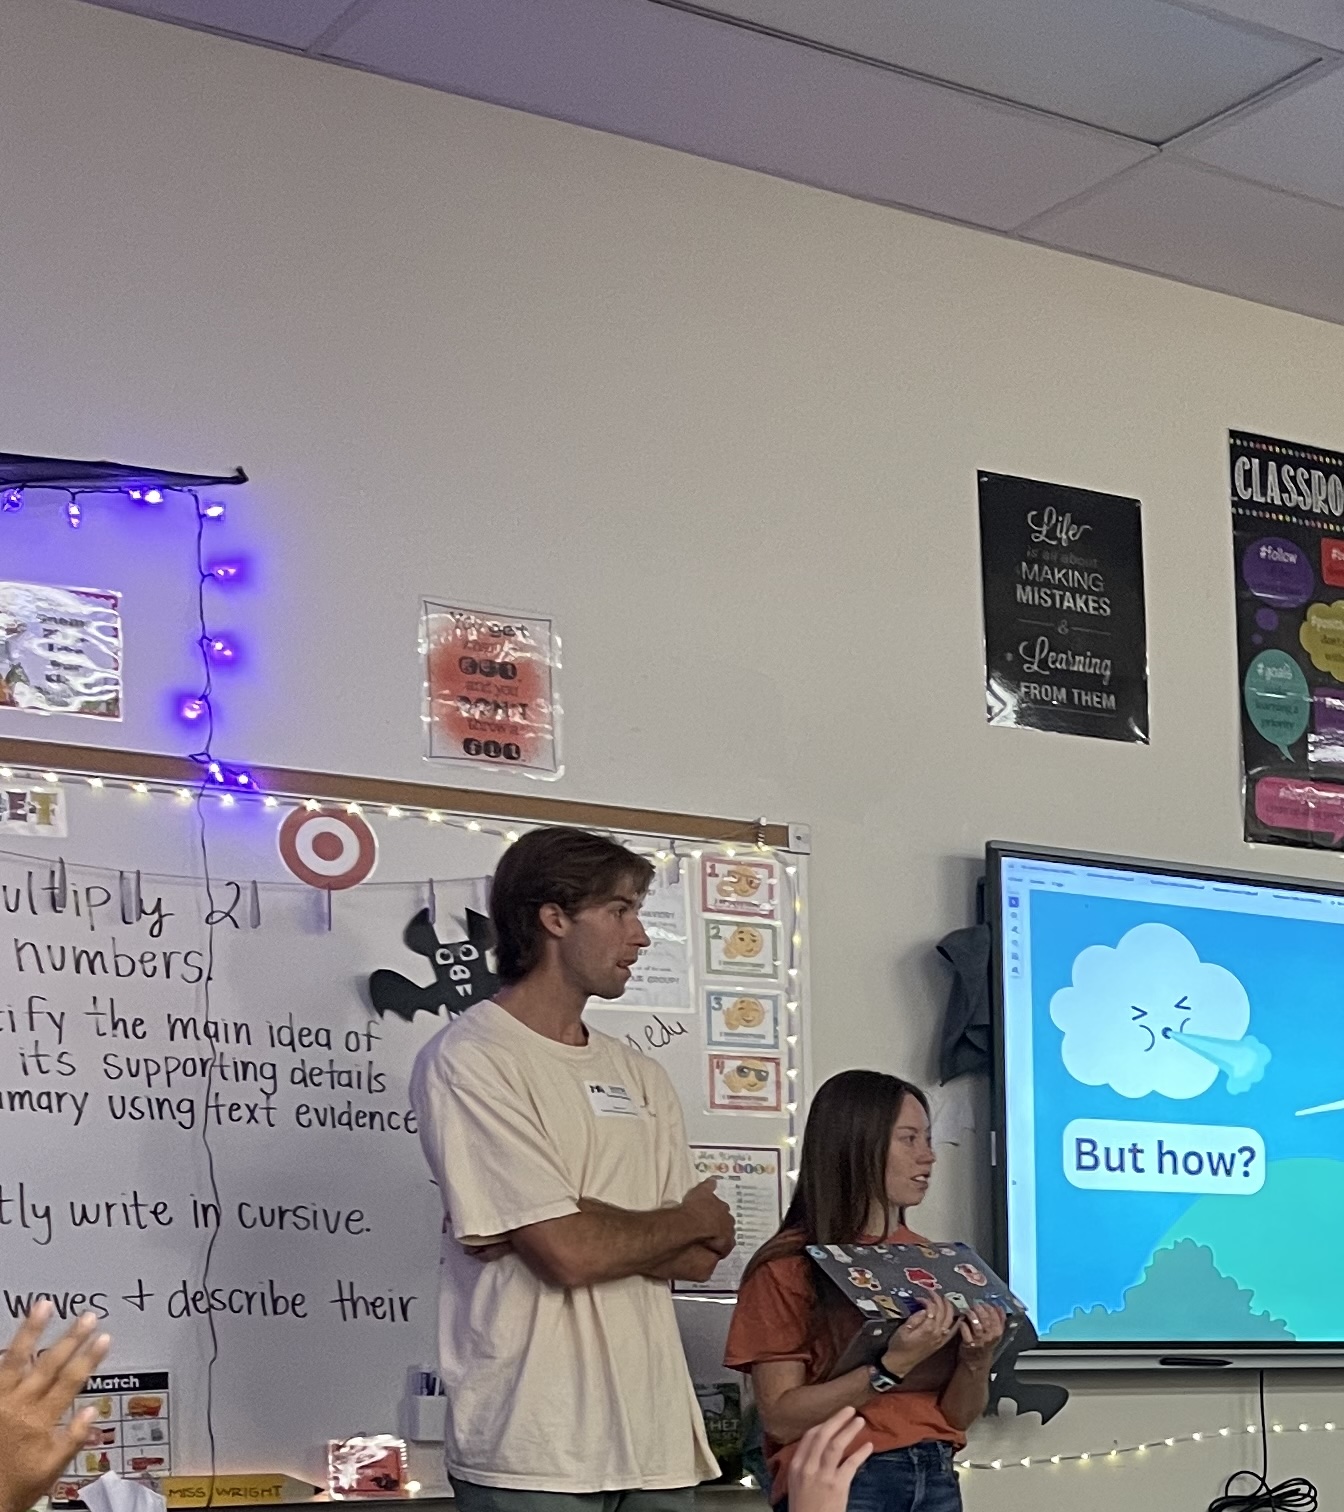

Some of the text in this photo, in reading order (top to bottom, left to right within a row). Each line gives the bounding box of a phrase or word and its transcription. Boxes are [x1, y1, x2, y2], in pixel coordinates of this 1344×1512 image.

[1027, 506, 1093, 547] Life
[1020, 561, 1106, 592] MAKING
[1016, 583, 1112, 616] MISTAKES
[1018, 636, 1112, 686] Learning
[1020, 682, 1117, 710] FROM THEM
[14, 936, 213, 984] numbers.
[84, 995, 147, 1040] the
[168, 1012, 252, 1046] main
[266, 1012, 333, 1053] idea
[345, 1018, 383, 1053] of
[19, 1040, 387, 1096] its supporting details
[108, 1093, 419, 1133] using text evidence
[1074, 1137, 1257, 1180] But how?
[69, 1191, 371, 1235] write in cursive.
[168, 1280, 309, 1320] describe
[330, 1279, 418, 1323] their
[86, 1376, 140, 1392] Match
[168, 1485, 283, 1498] MISS WRIGHT
